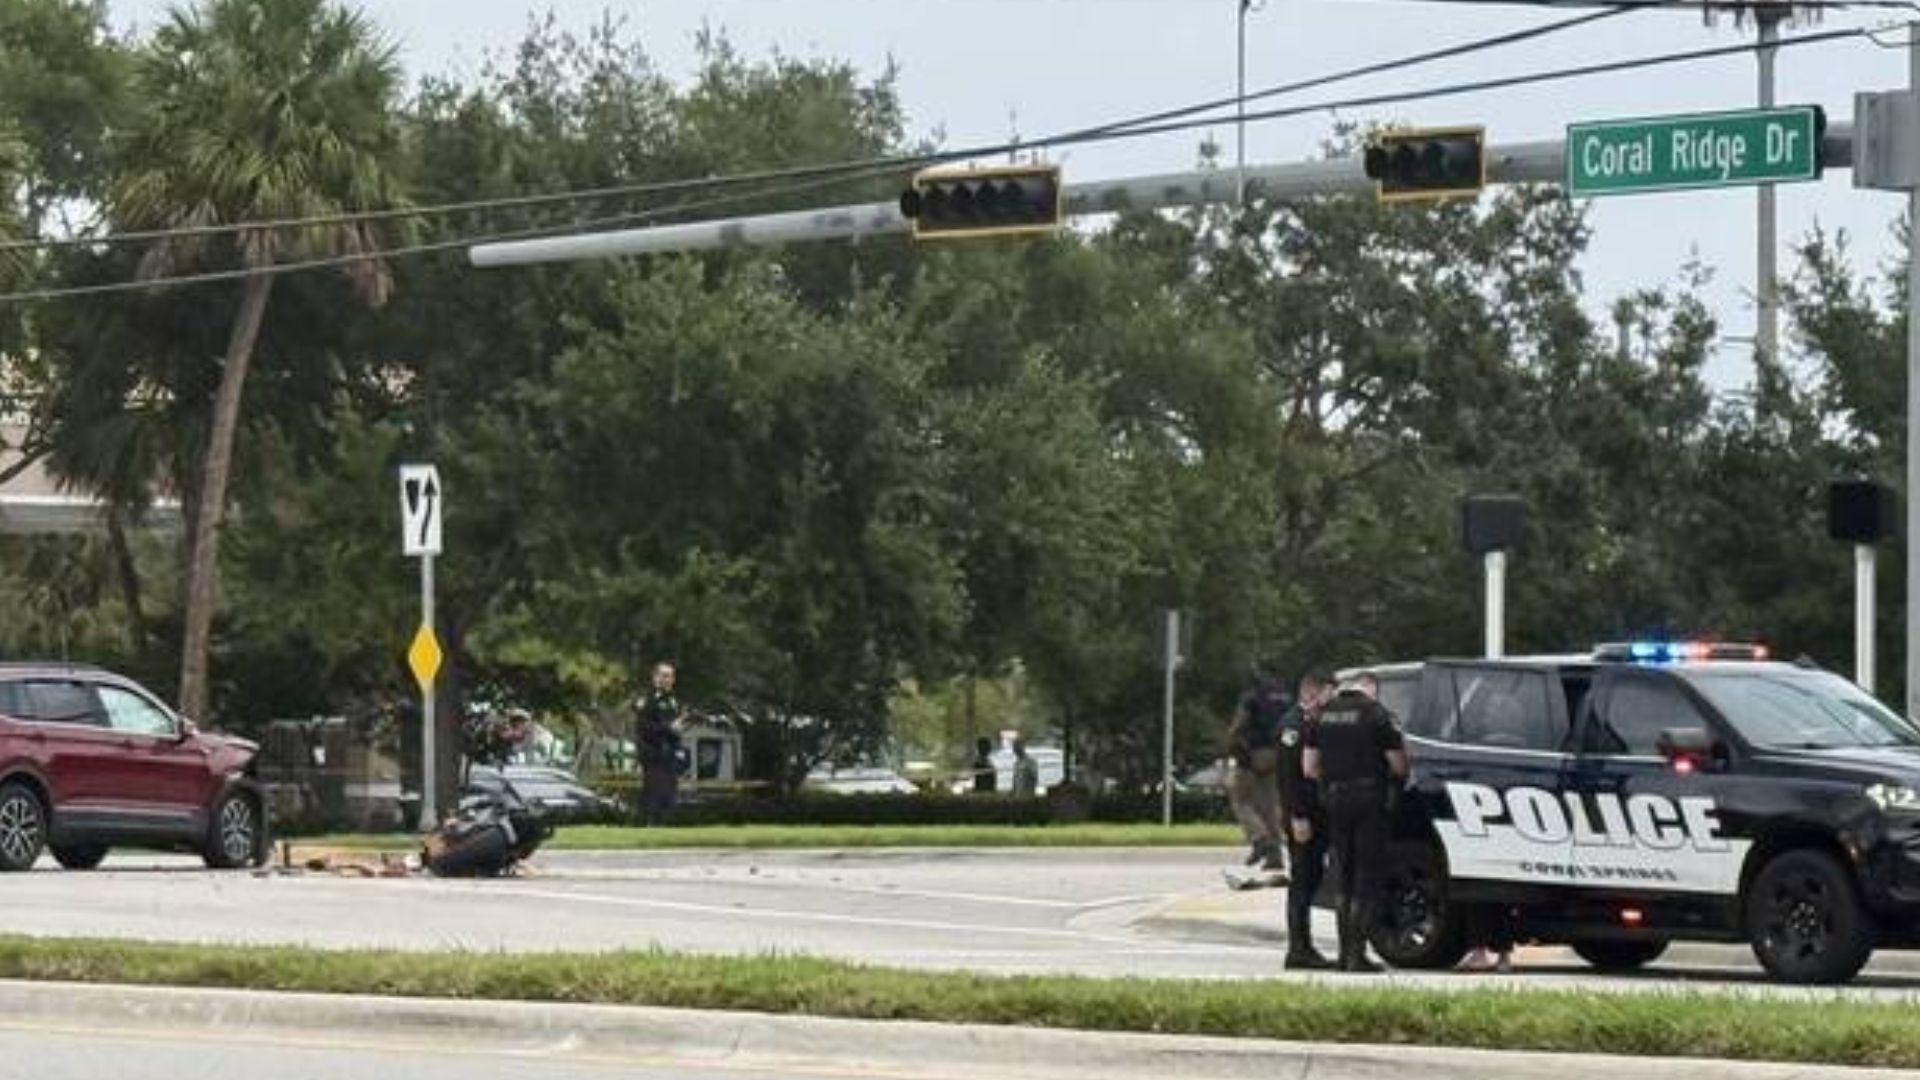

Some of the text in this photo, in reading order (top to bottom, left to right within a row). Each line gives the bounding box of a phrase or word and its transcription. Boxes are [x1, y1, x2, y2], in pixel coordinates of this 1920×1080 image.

[1582, 122, 1799, 180] Coral Ridge Dr
[1444, 780, 1733, 853] POLICE
